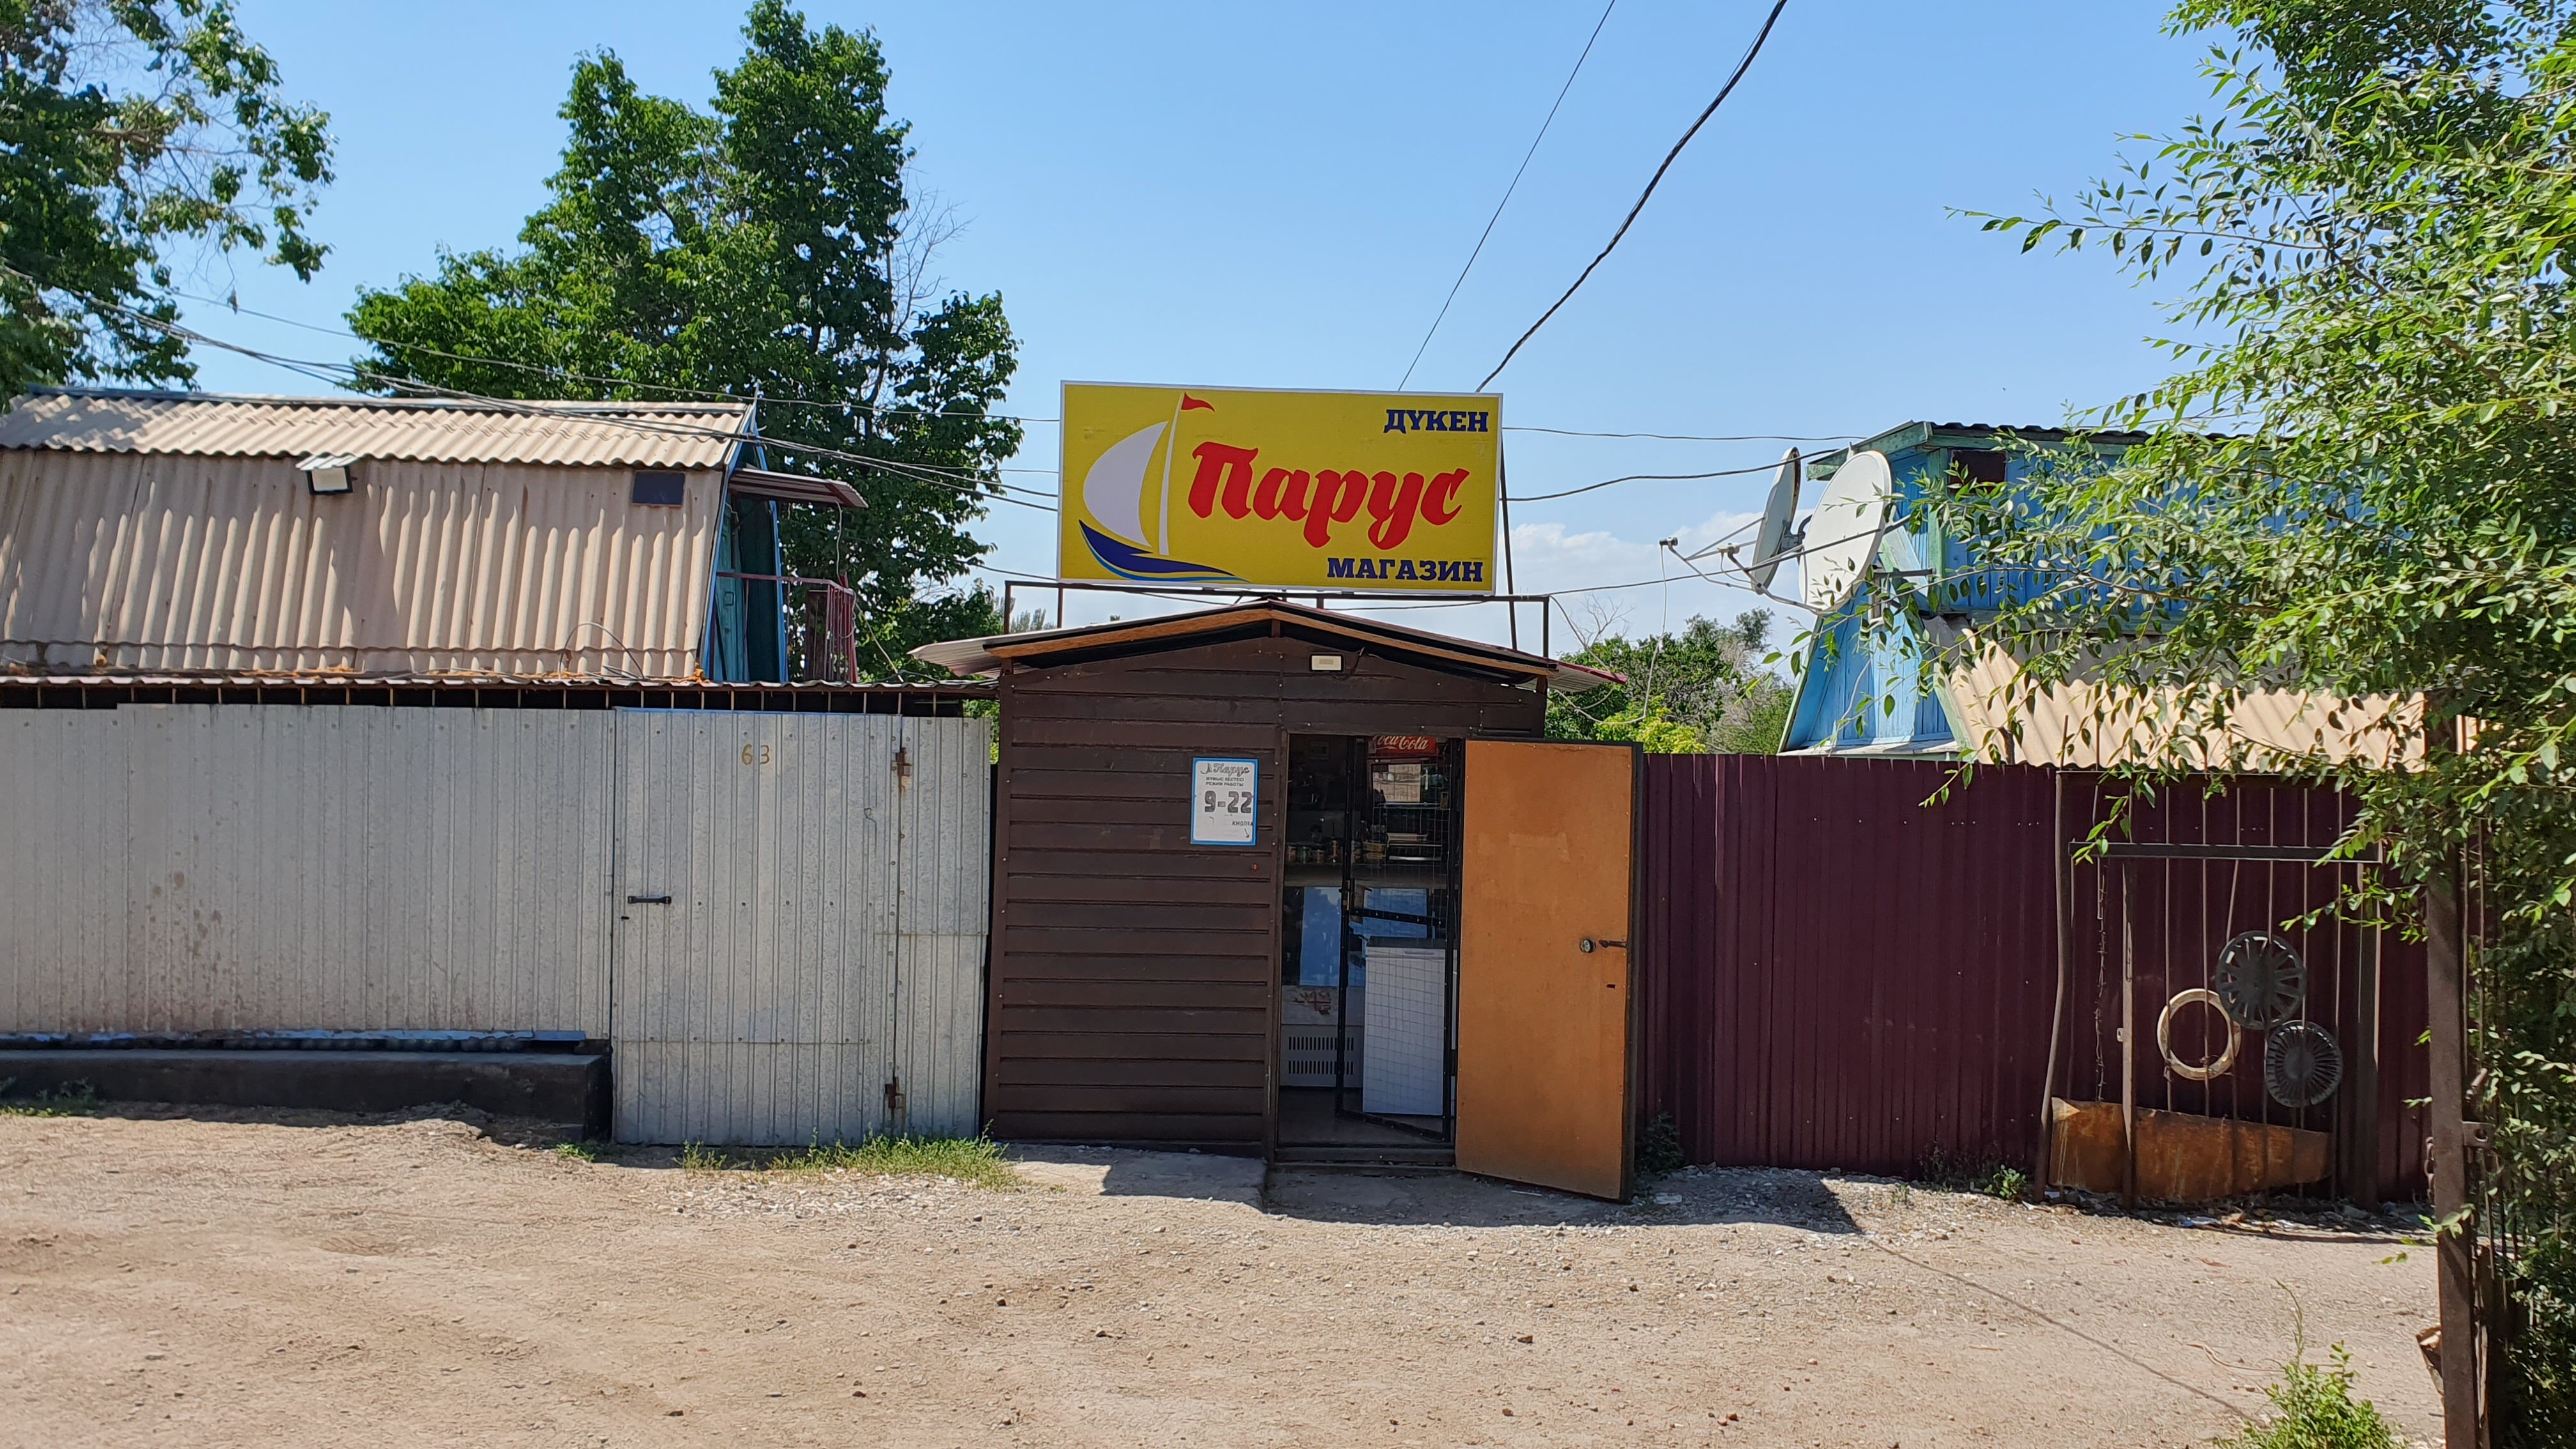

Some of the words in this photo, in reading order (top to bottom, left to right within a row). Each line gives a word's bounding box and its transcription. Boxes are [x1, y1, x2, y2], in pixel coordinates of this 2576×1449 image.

[1383, 410, 1489, 434] ДҮКЕН
[1188, 441, 1470, 550] Парус
[1326, 557, 1483, 583] МАГАЗИН
[741, 744, 770, 765] 63
[1213, 763, 1250, 777] Парус
[1204, 790, 1252, 813] 9-22
